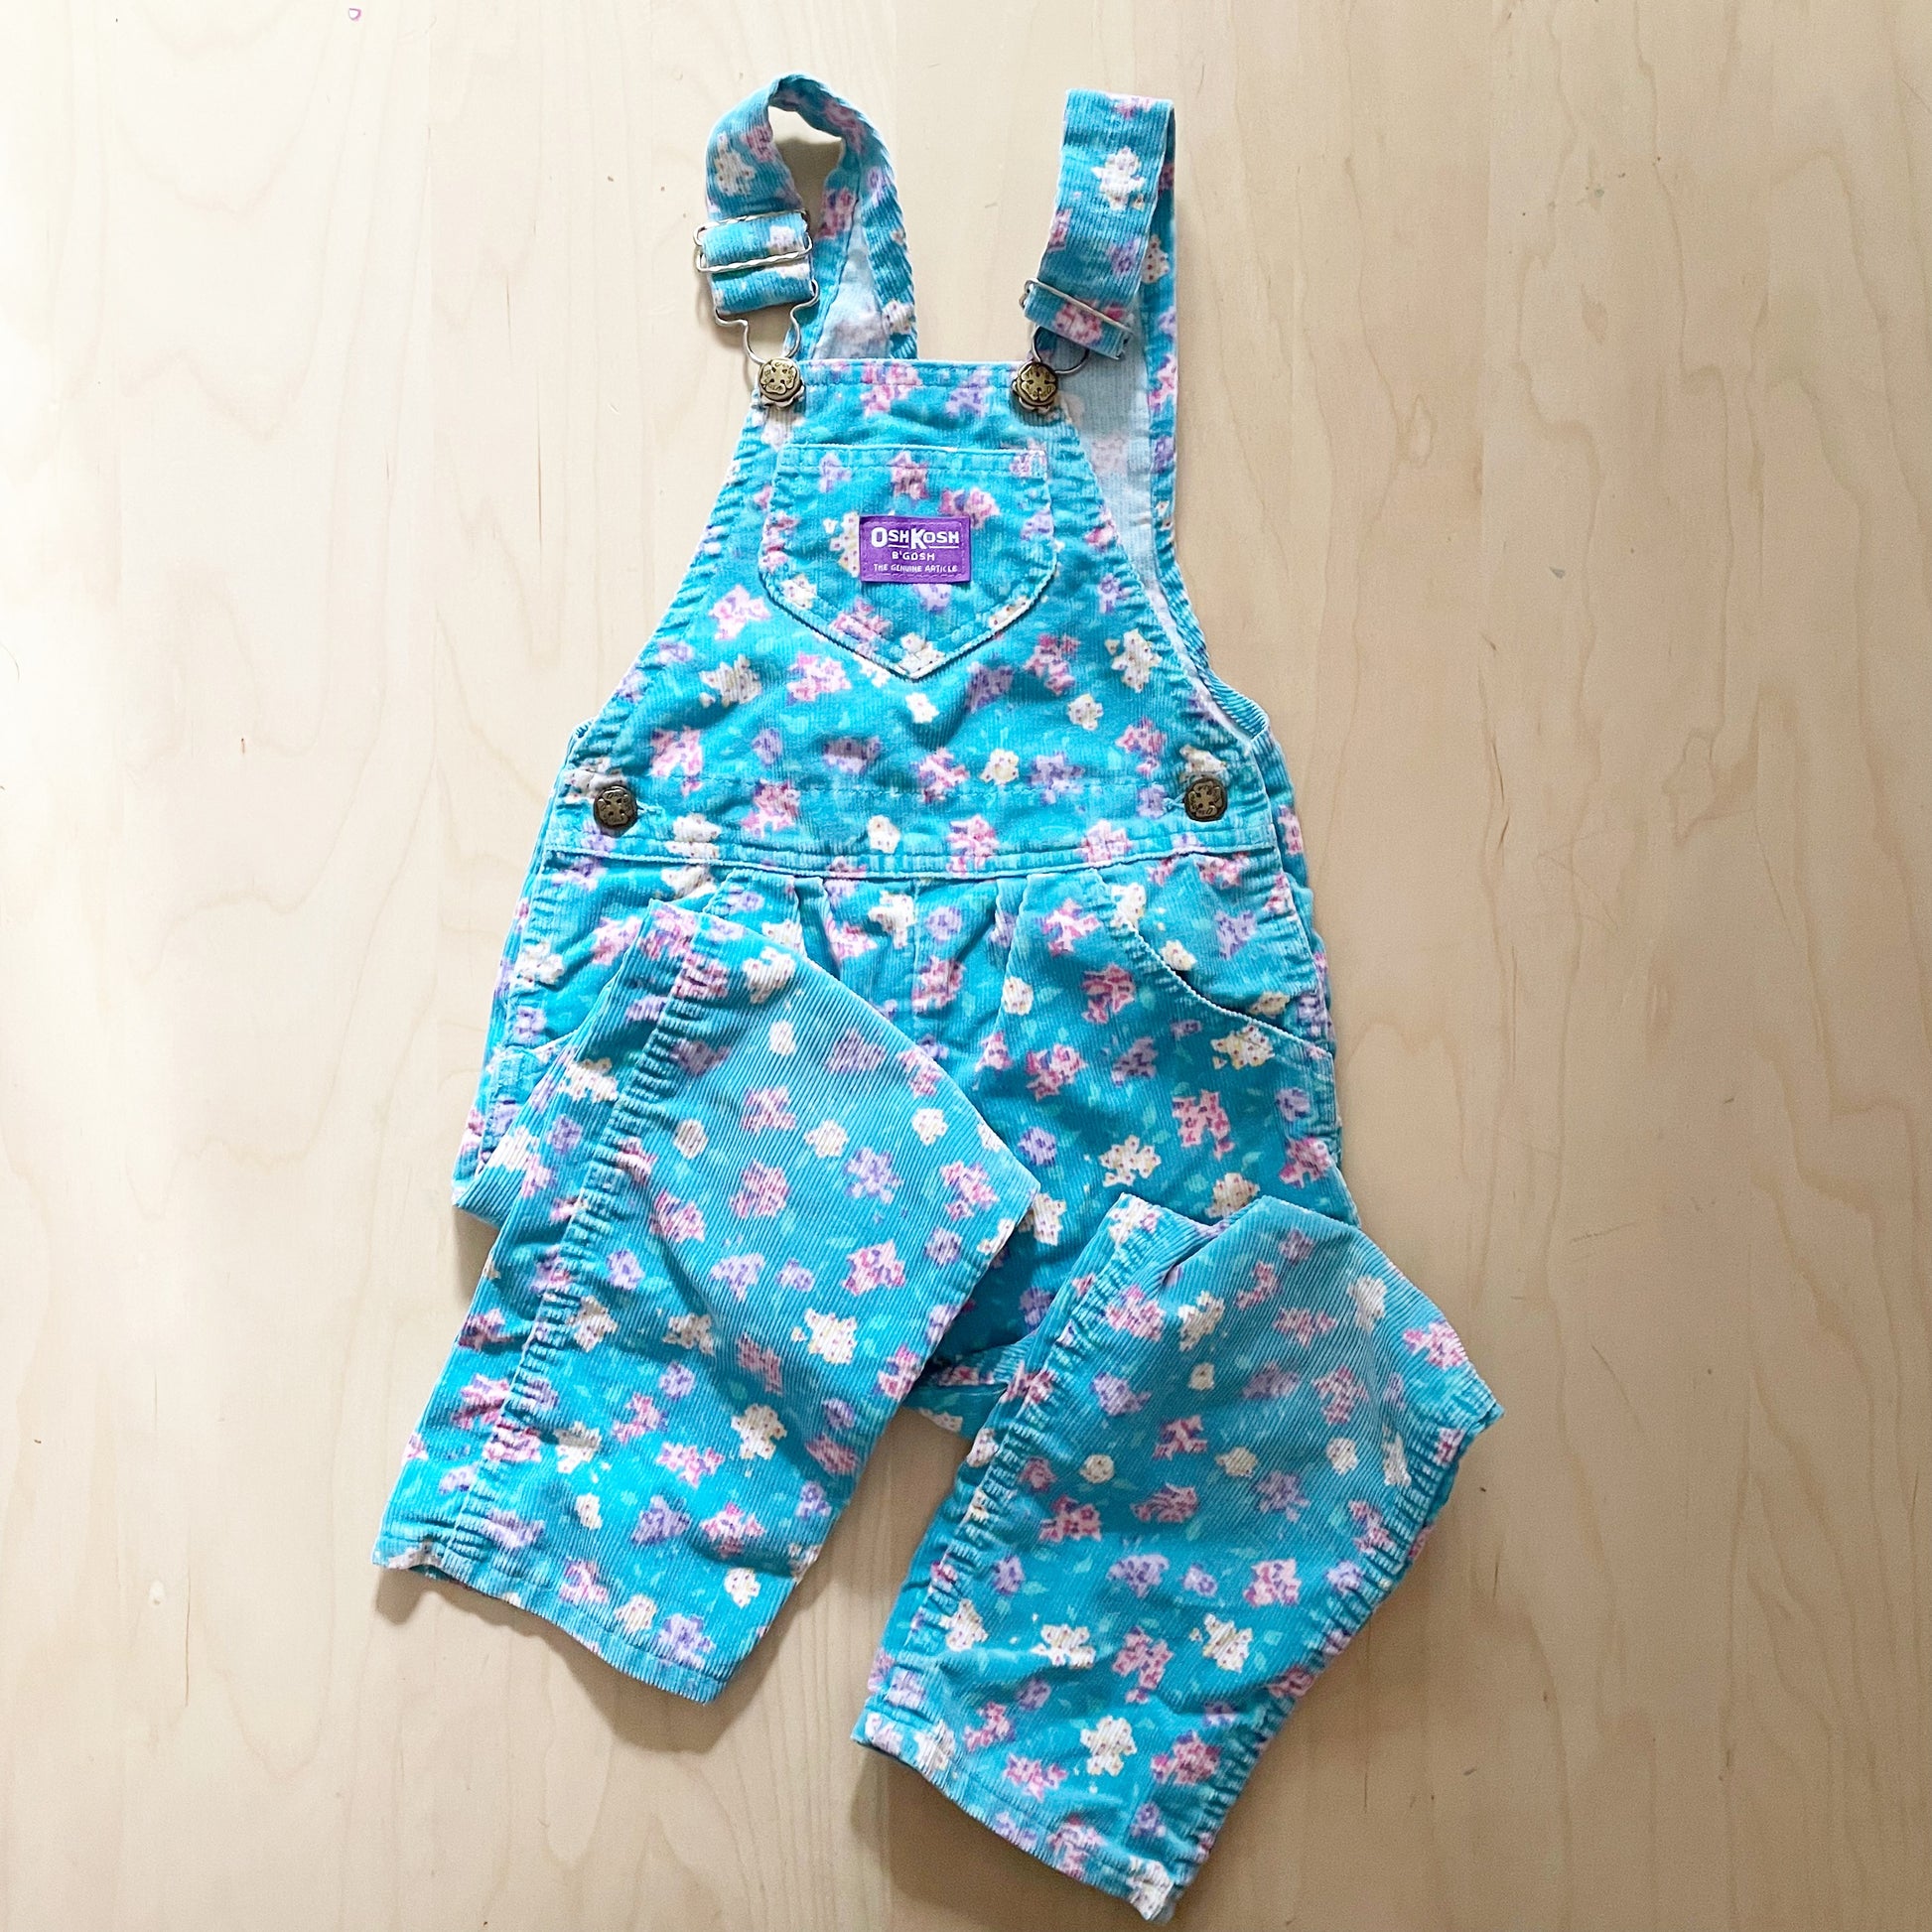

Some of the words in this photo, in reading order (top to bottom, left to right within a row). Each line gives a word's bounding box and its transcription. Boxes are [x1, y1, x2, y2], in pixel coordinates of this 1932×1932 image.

[892, 551, 935, 561] B'GOSH
[874, 563, 888, 572] THE
[891, 564, 922, 573] GENUINE
[924, 564, 958, 573] ARTICLE
